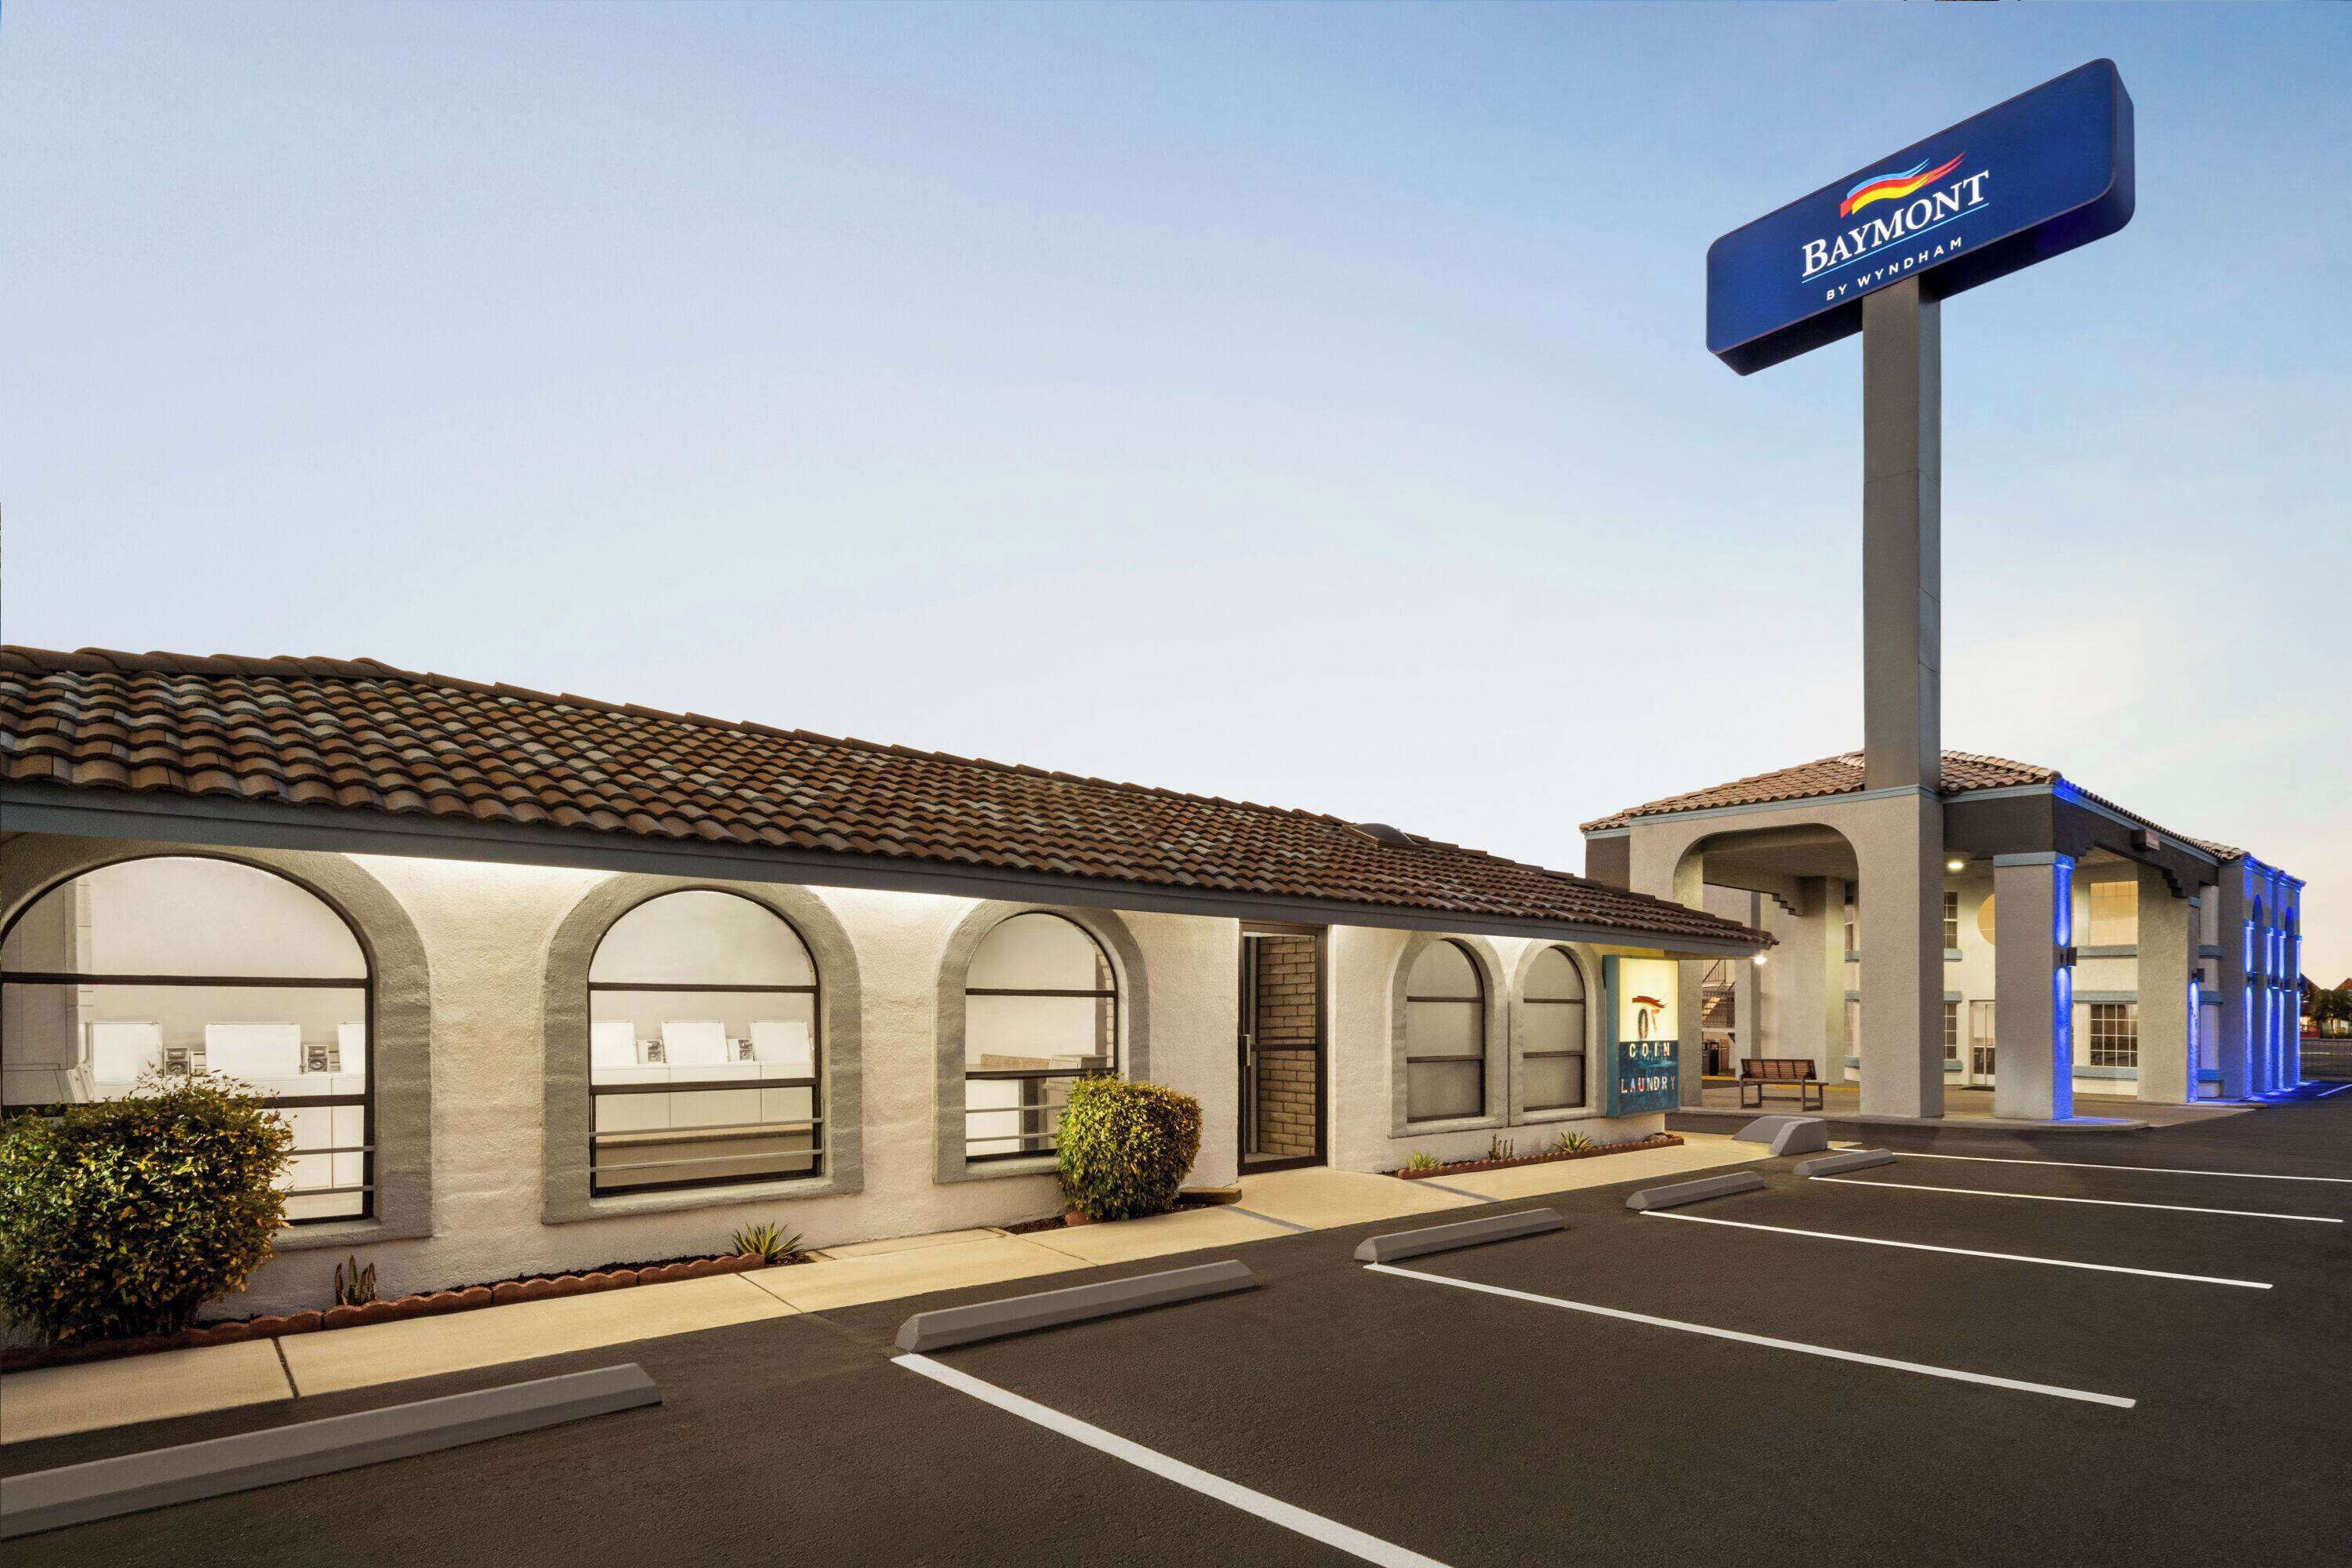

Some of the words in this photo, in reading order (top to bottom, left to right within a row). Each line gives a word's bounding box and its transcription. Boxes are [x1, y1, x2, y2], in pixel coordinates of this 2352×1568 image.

[1802, 170, 1989, 278] BAYMONT
[1826, 283, 1848, 301] BY
[1857, 237, 1962, 288] WYNDHAM
[1629, 1042, 1670, 1058] COIN
[1621, 1076, 1675, 1093] LAUNDRY
